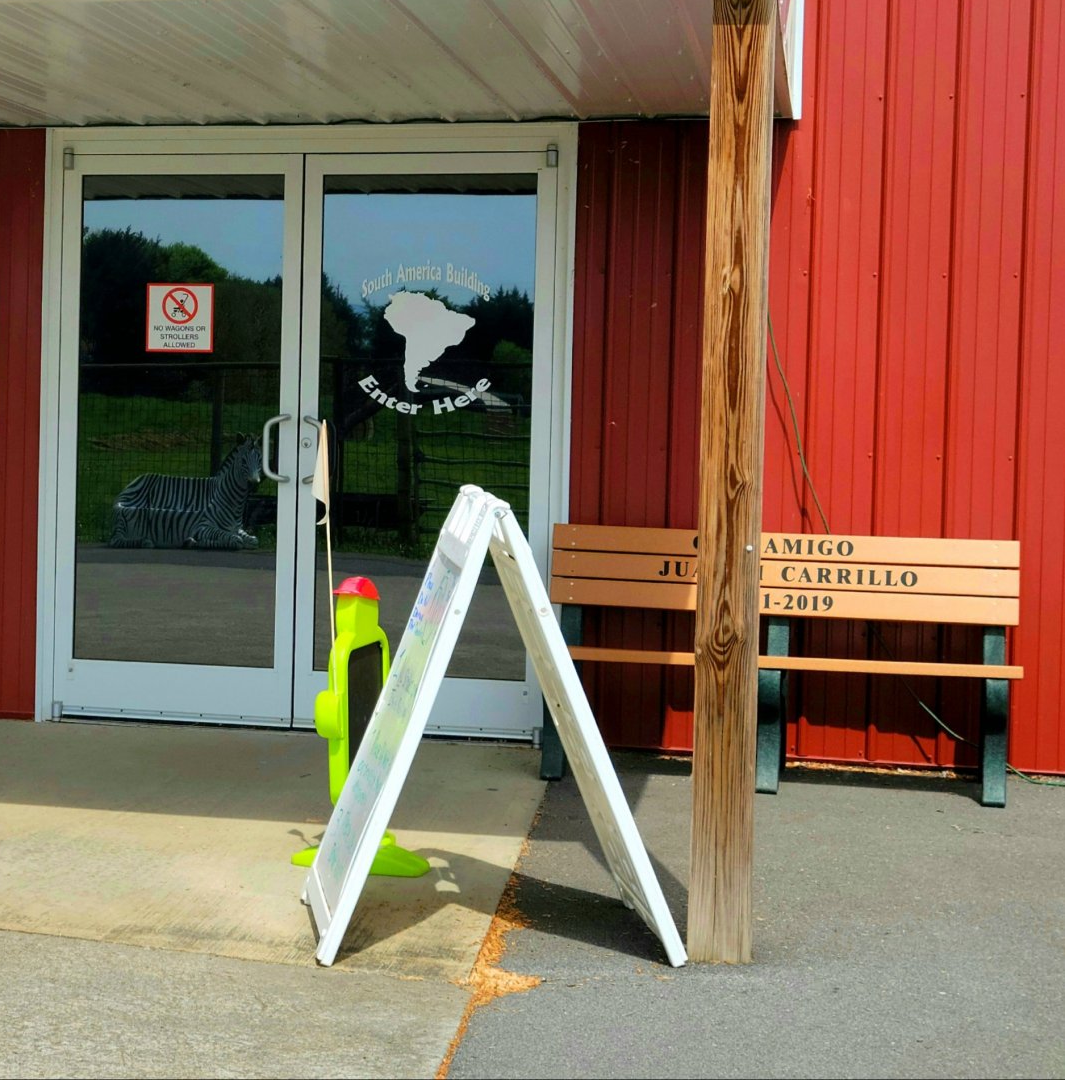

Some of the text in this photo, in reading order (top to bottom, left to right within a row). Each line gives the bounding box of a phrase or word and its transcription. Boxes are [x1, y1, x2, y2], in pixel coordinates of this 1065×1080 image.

[361, 259, 491, 302] South America Building
[358, 374, 492, 415] Enter Here
[764, 538, 854, 556] AMIGO
[781, 566, 918, 587] CARRILLO
[764, 593, 833, 611] 1-2019
